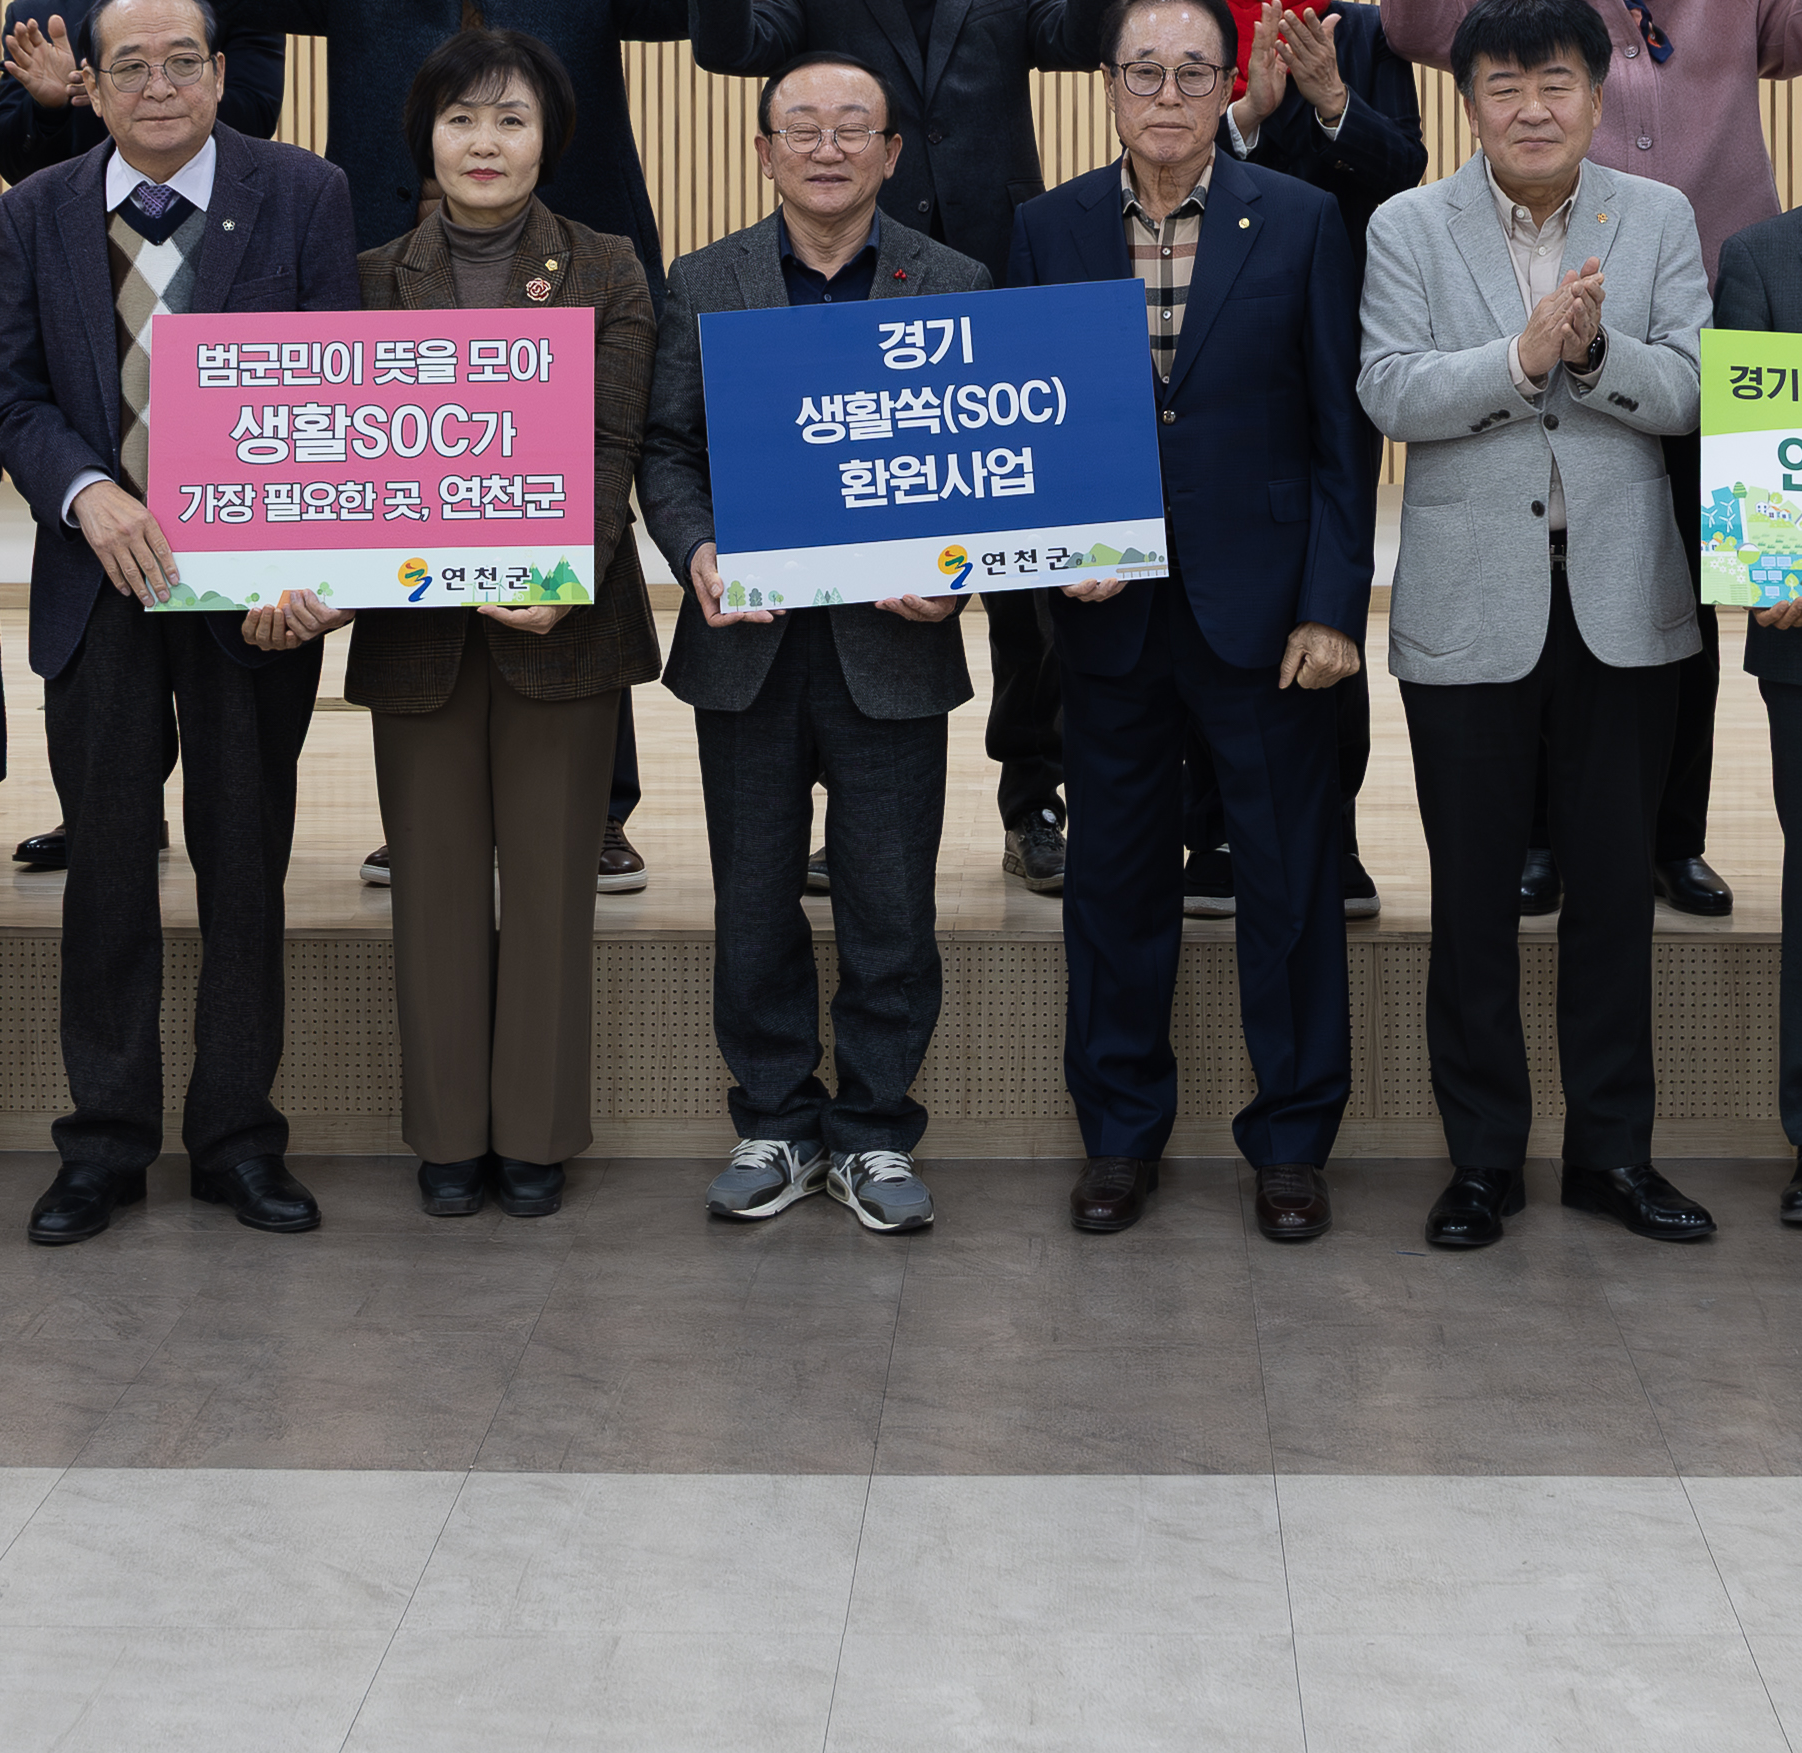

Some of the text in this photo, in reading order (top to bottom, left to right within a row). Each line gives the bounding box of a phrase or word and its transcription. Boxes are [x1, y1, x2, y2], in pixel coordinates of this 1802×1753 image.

[197, 338, 554, 388] 범군민이 뜻을 모아
[878, 316, 974, 370] 경기
[230, 402, 517, 464] 생활SOC가
[795, 375, 1067, 444] 생활쏙(SOC)
[179, 474, 565, 524] 가장 필요한 곳, 연천군
[838, 446, 1035, 509] 환원사업
[441, 565, 530, 592] 연천군
[981, 547, 1070, 576] 연천군
